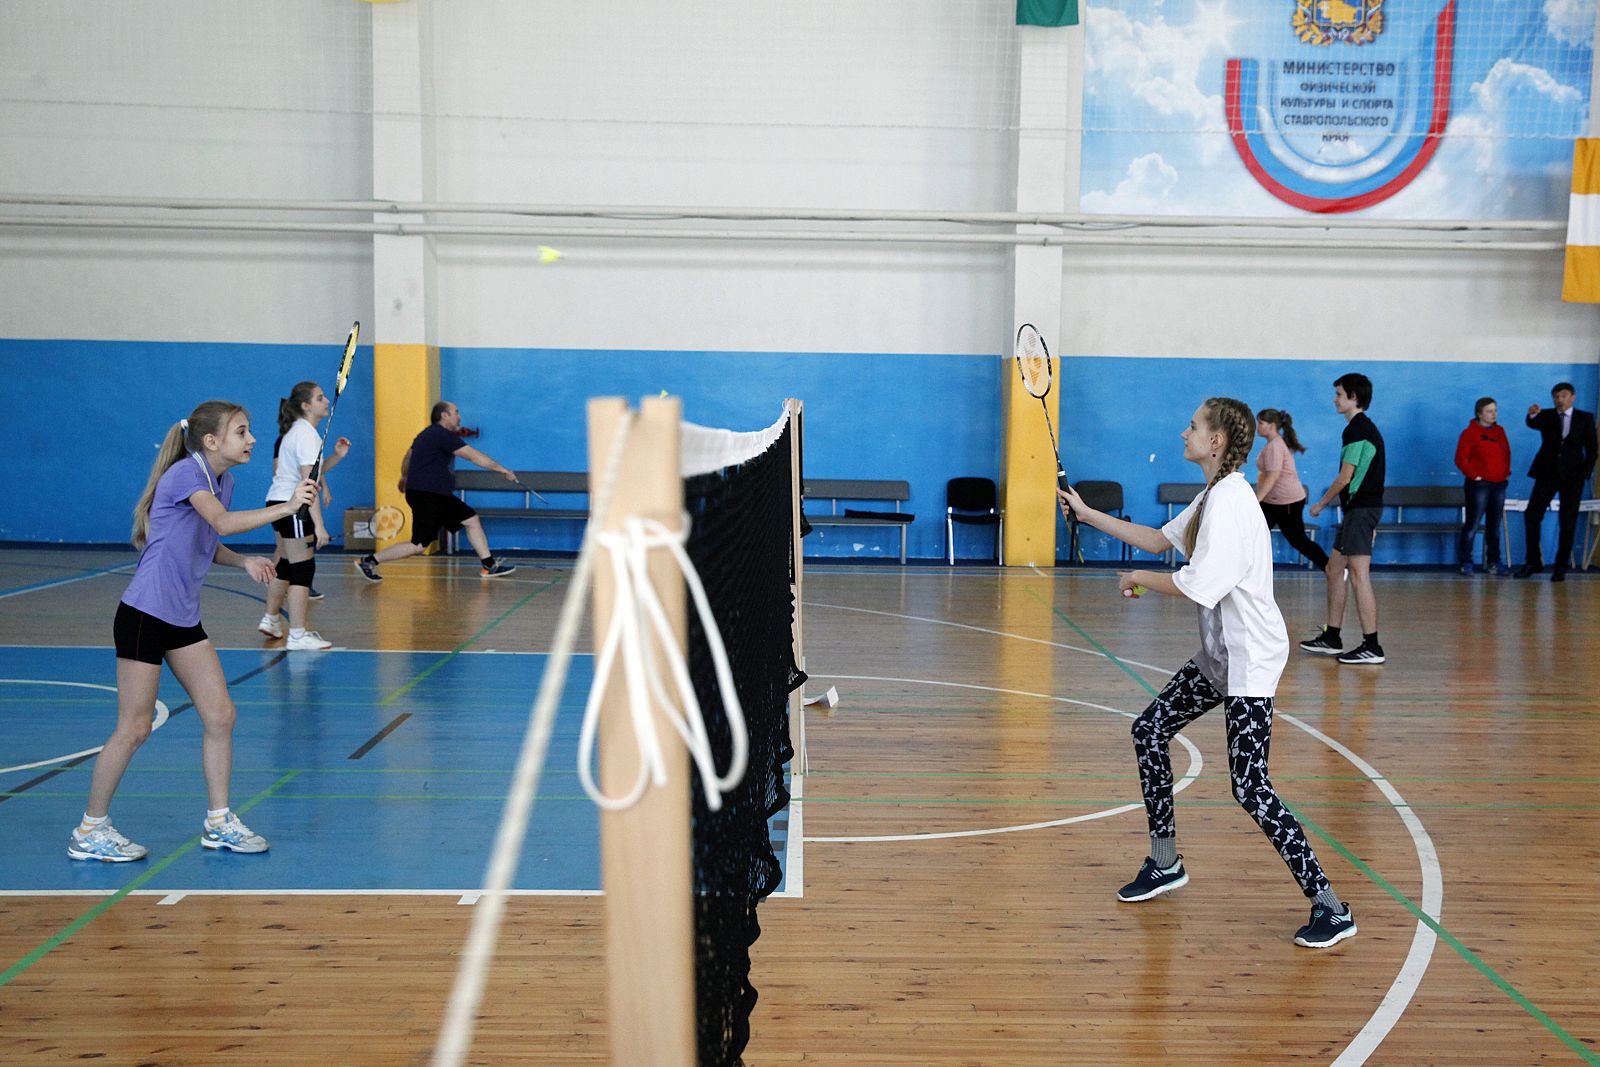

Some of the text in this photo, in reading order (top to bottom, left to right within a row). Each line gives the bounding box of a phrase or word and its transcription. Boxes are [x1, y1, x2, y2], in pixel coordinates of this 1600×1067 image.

[1283, 61, 1395, 76] МИНИСТЕРСТВО
[1300, 81, 1376, 93] ФИЗИЧЕСКОЙ
[1280, 97, 1394, 109] КУЛЬТУРЫ И СПОРТА
[1283, 114, 1389, 127] СТАВРОПОЛЬСКОГО
